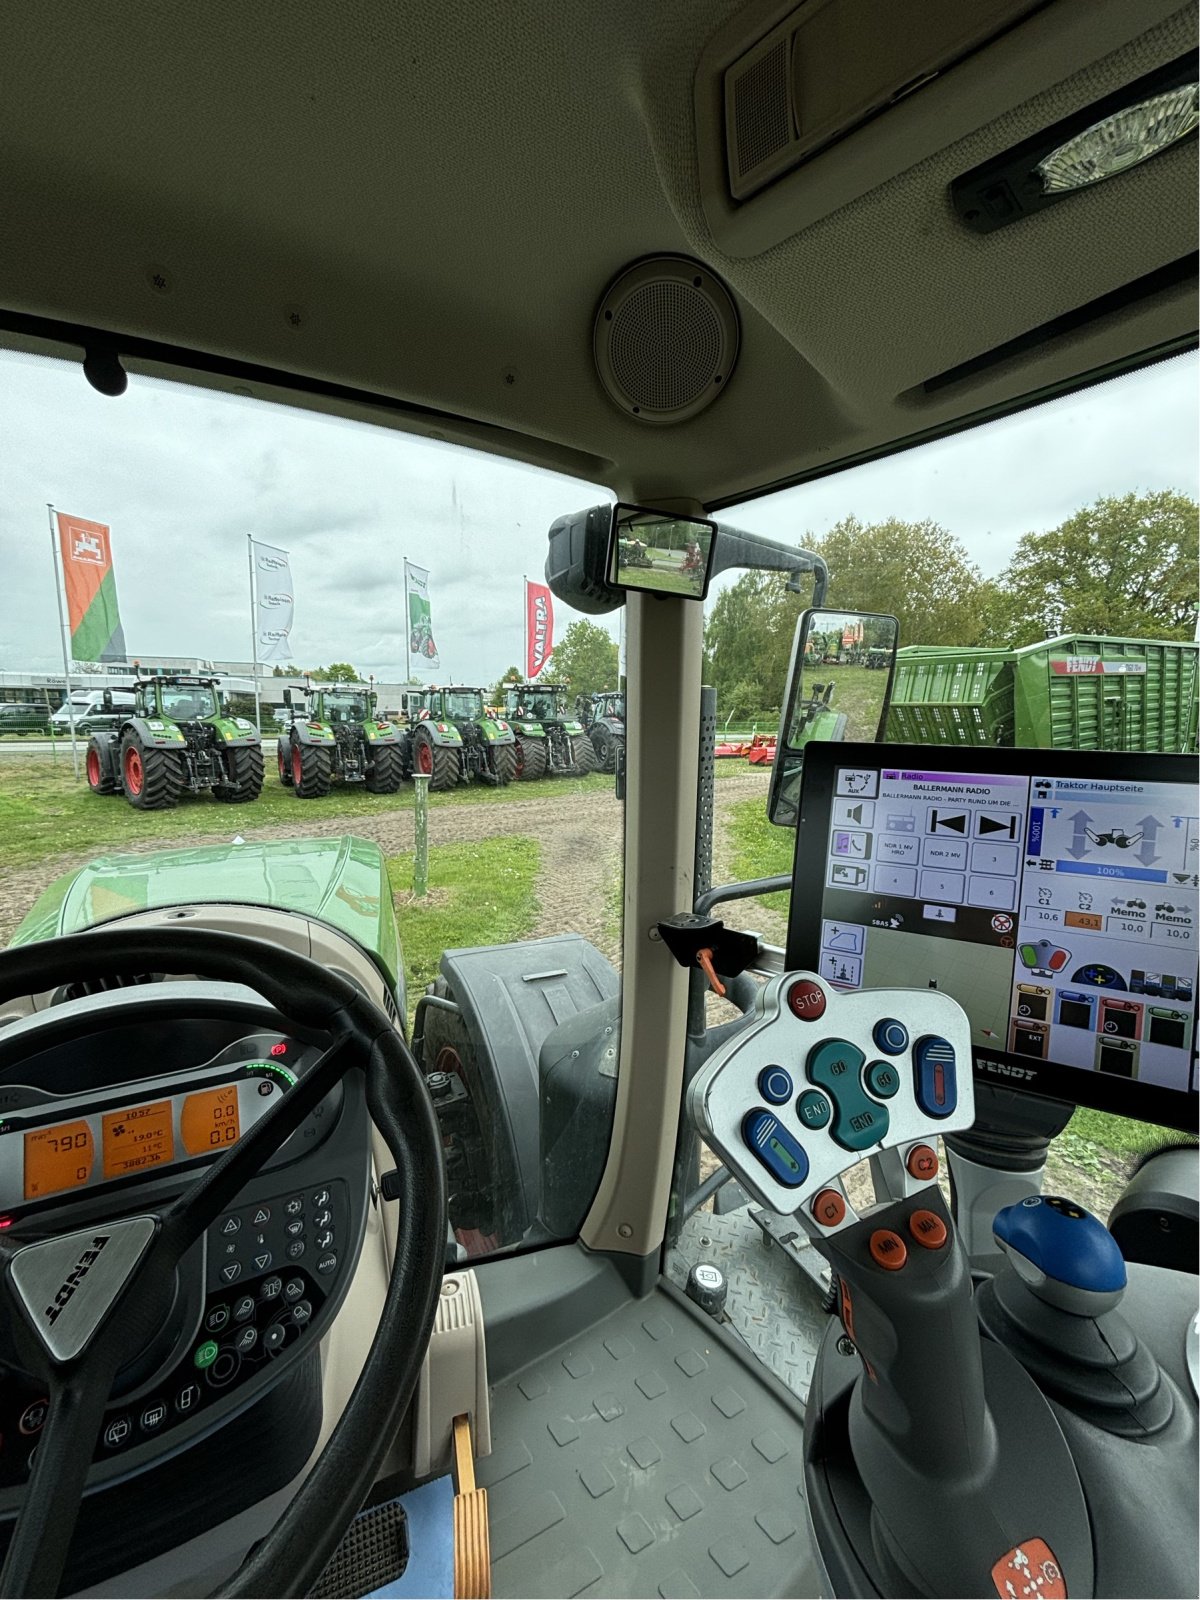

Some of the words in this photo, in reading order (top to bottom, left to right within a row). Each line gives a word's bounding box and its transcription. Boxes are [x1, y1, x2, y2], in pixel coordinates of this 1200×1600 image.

[533, 595, 548, 669] VALTRA
[1066, 656, 1098, 672] FENDT
[901, 772, 924, 780] Radio
[913, 784, 963, 794] BALLERMANN
[965, 787, 991, 795] RADIO
[1055, 781, 1088, 790] Traktor
[1090, 783, 1144, 793] Hauptseite
[882, 793, 921, 801] BALLERMANN
[1031, 821, 1041, 842] 100%
[1096, 866, 1125, 877] 100%
[1038, 898, 1051, 906] C1
[1079, 903, 1091, 911] C2
[1110, 907, 1146, 919] Memo
[1155, 912, 1192, 924] Memo
[872, 919, 889, 927] SBAS
[796, 990, 823, 1010] STOP
[1028, 1034, 1042, 1042] EXT
[830, 1060, 847, 1076] GO
[976, 1058, 1037, 1081] FENDT
[876, 1071, 892, 1087] GO
[214, 1105, 234, 1119] 0.0
[804, 1100, 829, 1120] END
[849, 1111, 875, 1132] END
[47, 1132, 87, 1152] 790
[210, 1126, 236, 1144] 0.0
[918, 1156, 934, 1170] C2
[76, 1166, 87, 1180] 0
[824, 1205, 839, 1220] C1
[918, 1218, 940, 1234] MAX
[876, 1238, 899, 1255] MIN
[319, 1258, 336, 1269] AUTO
[44, 1235, 111, 1326] FENDT
